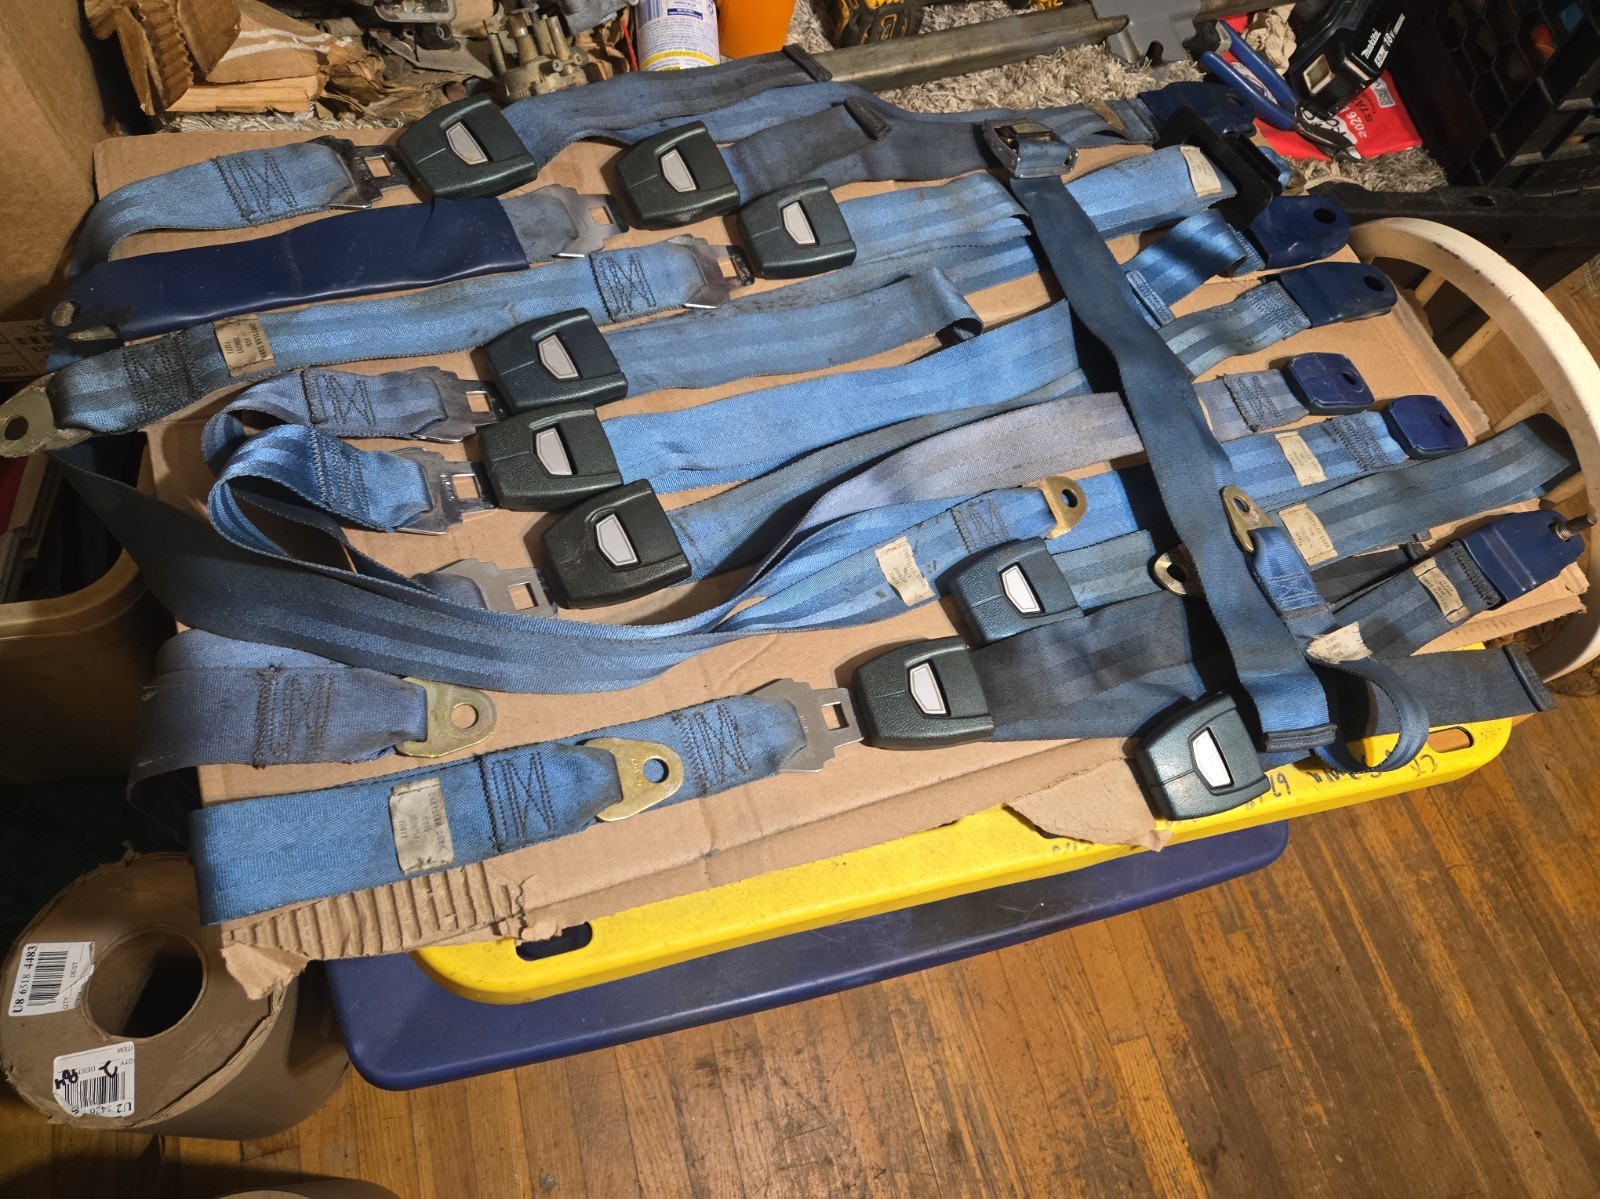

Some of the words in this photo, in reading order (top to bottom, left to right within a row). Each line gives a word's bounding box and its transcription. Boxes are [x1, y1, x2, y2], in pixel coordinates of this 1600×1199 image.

[1344, 111, 1368, 138] 2026
[248, 321, 263, 345] CHRYSLER
[427, 791, 443, 827] CHRYSLER
[22, 945, 37, 969] 4483
[69, 960, 78, 977] DEST
[17, 972, 31, 994] 6518
[12, 997, 25, 1013] U8
[77, 1065, 96, 1074] DEST
[119, 1057, 133, 1065] QTY
[116, 1101, 132, 1113] U2
